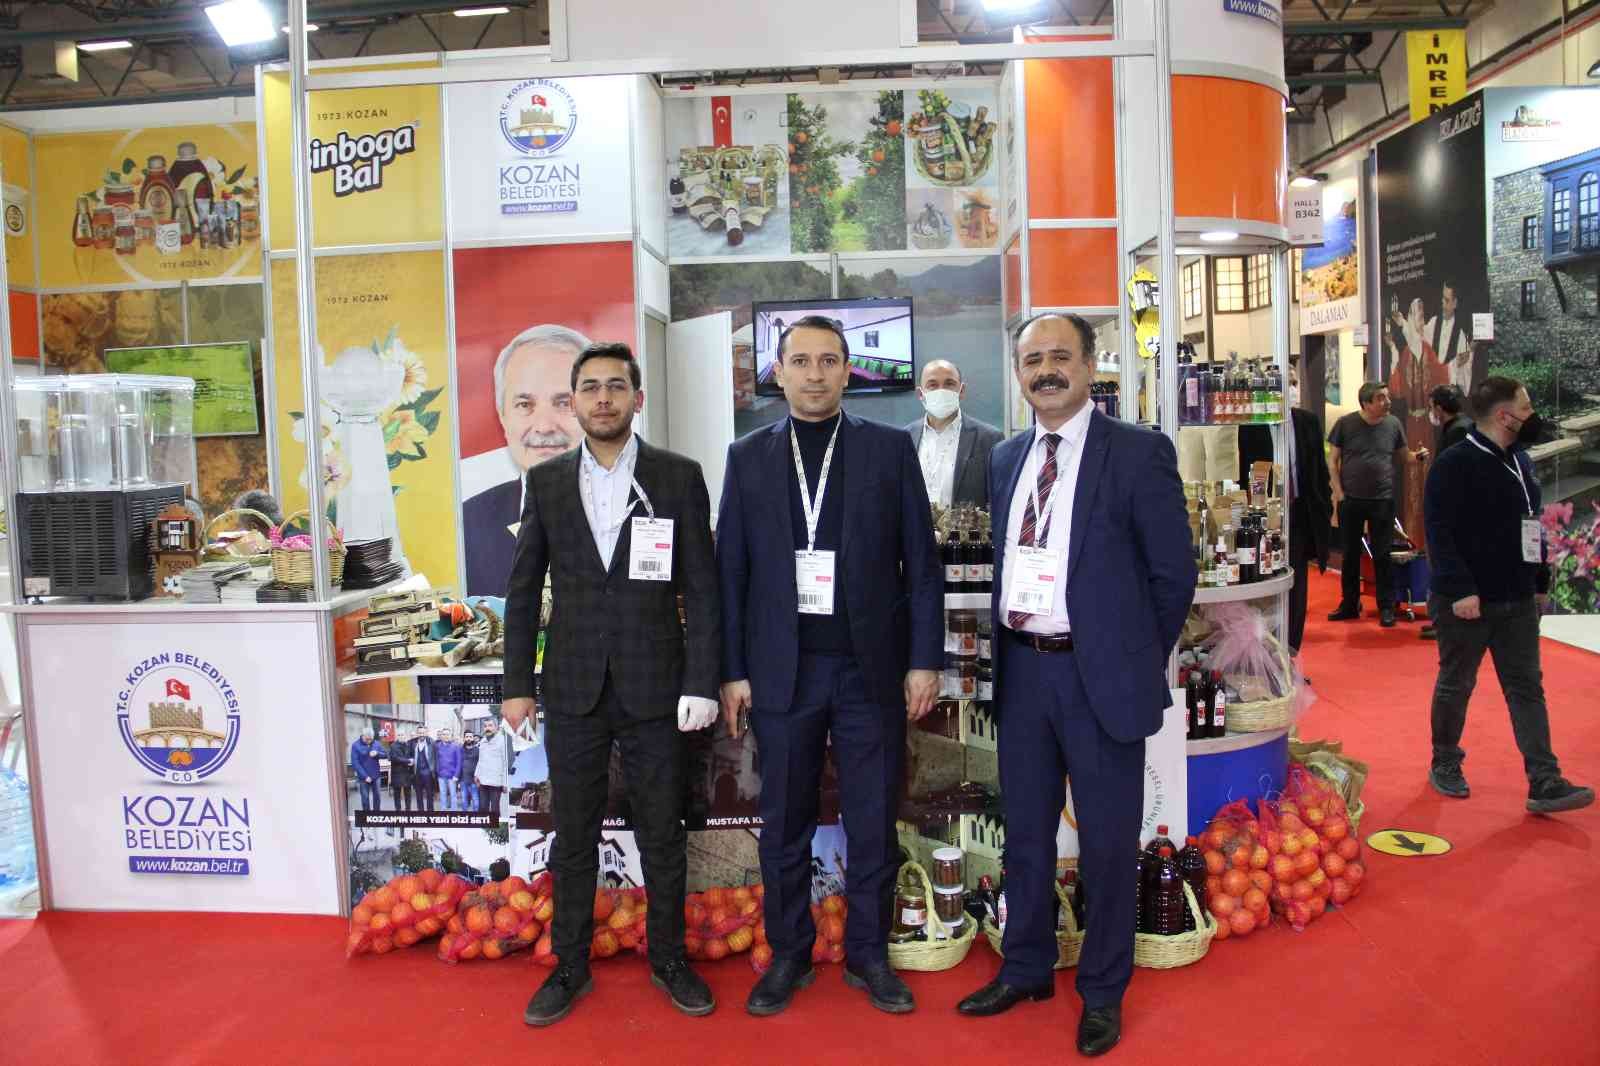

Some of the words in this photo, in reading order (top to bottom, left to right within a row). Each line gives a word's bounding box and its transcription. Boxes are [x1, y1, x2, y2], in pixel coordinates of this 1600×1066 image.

[346, 109, 388, 119] KOZAN
[310, 126, 415, 172] inboga
[335, 156, 382, 197] Bal
[500, 164, 579, 185] KOZAN
[1295, 209, 1321, 218] B342
[352, 294, 389, 304] KOZAN
[1310, 303, 1349, 325] DALAMAN
[117, 690, 131, 712] T.C.
[126, 653, 170, 685] KOZAN
[123, 796, 249, 827] KOZAN
[410, 816, 427, 824] HER
[706, 817, 751, 826] MUSTAFA
[136, 858, 244, 873] www.kozan.bel.tr
